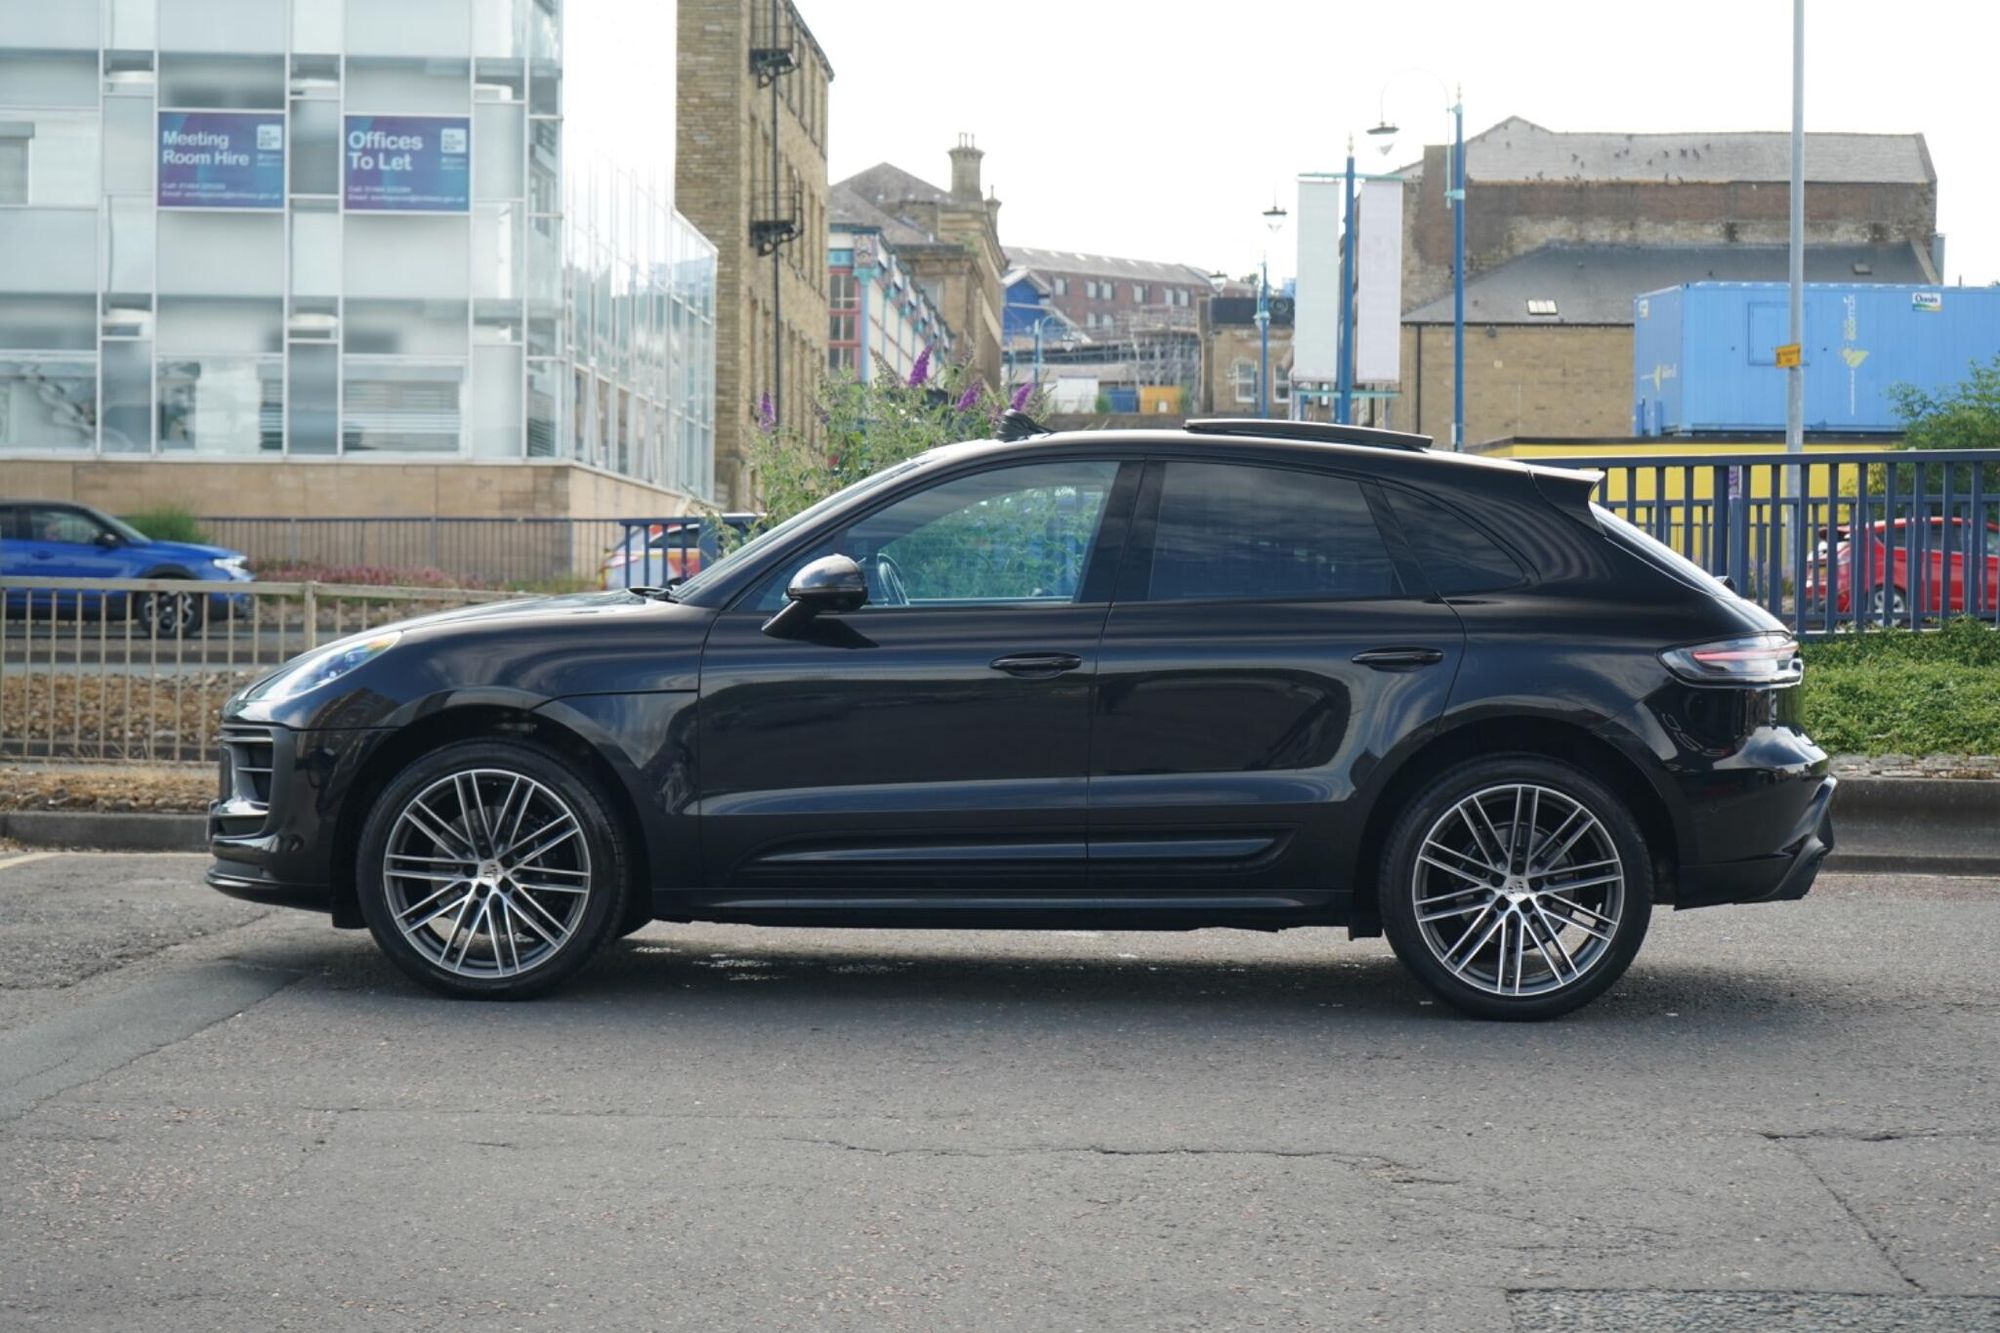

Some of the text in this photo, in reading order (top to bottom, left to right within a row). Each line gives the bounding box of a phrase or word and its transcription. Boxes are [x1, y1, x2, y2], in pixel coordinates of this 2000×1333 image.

[163, 130, 229, 150] Meeting
[348, 130, 424, 151] Offices
[163, 149, 211, 165] Room
[214, 150, 250, 166] Hire
[347, 151, 413, 171] To Let
